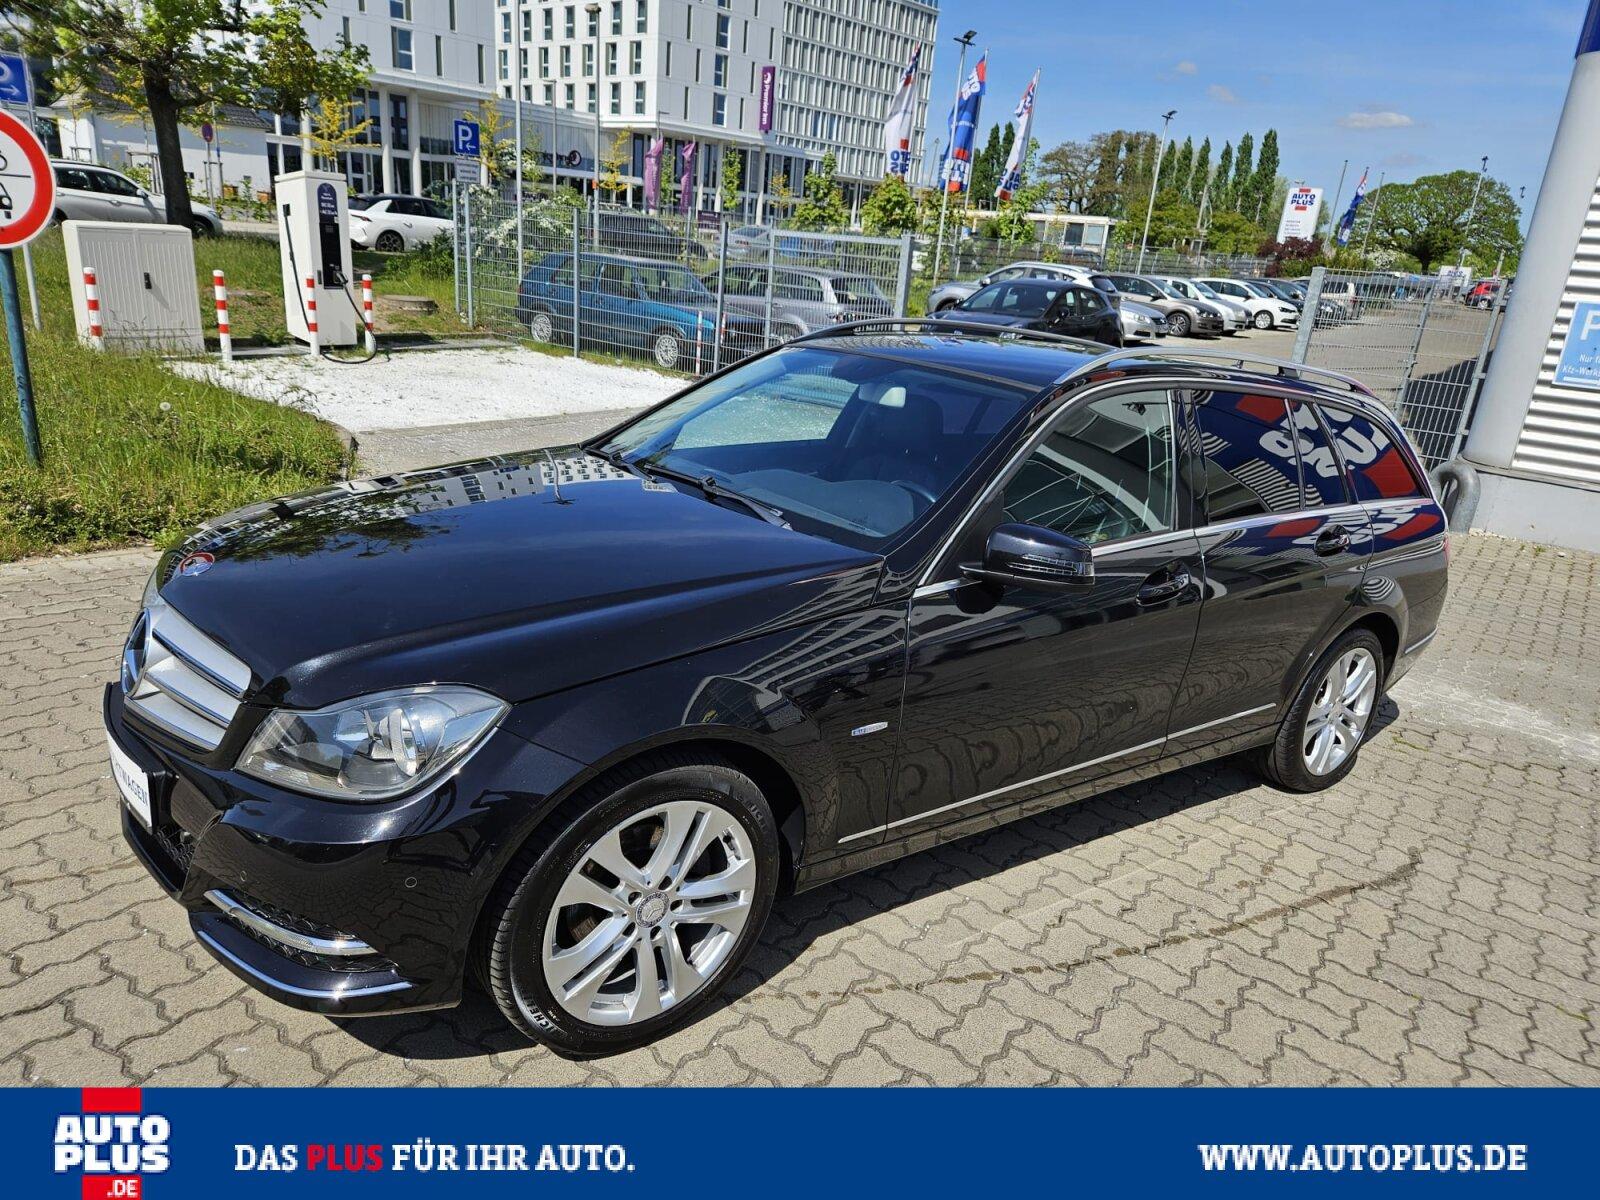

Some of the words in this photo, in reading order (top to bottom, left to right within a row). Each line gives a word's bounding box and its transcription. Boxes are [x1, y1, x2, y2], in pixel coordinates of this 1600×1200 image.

[763, 84, 771, 113] Premier
[458, 125, 473, 150] P
[1579, 354, 1593, 363] Nur
